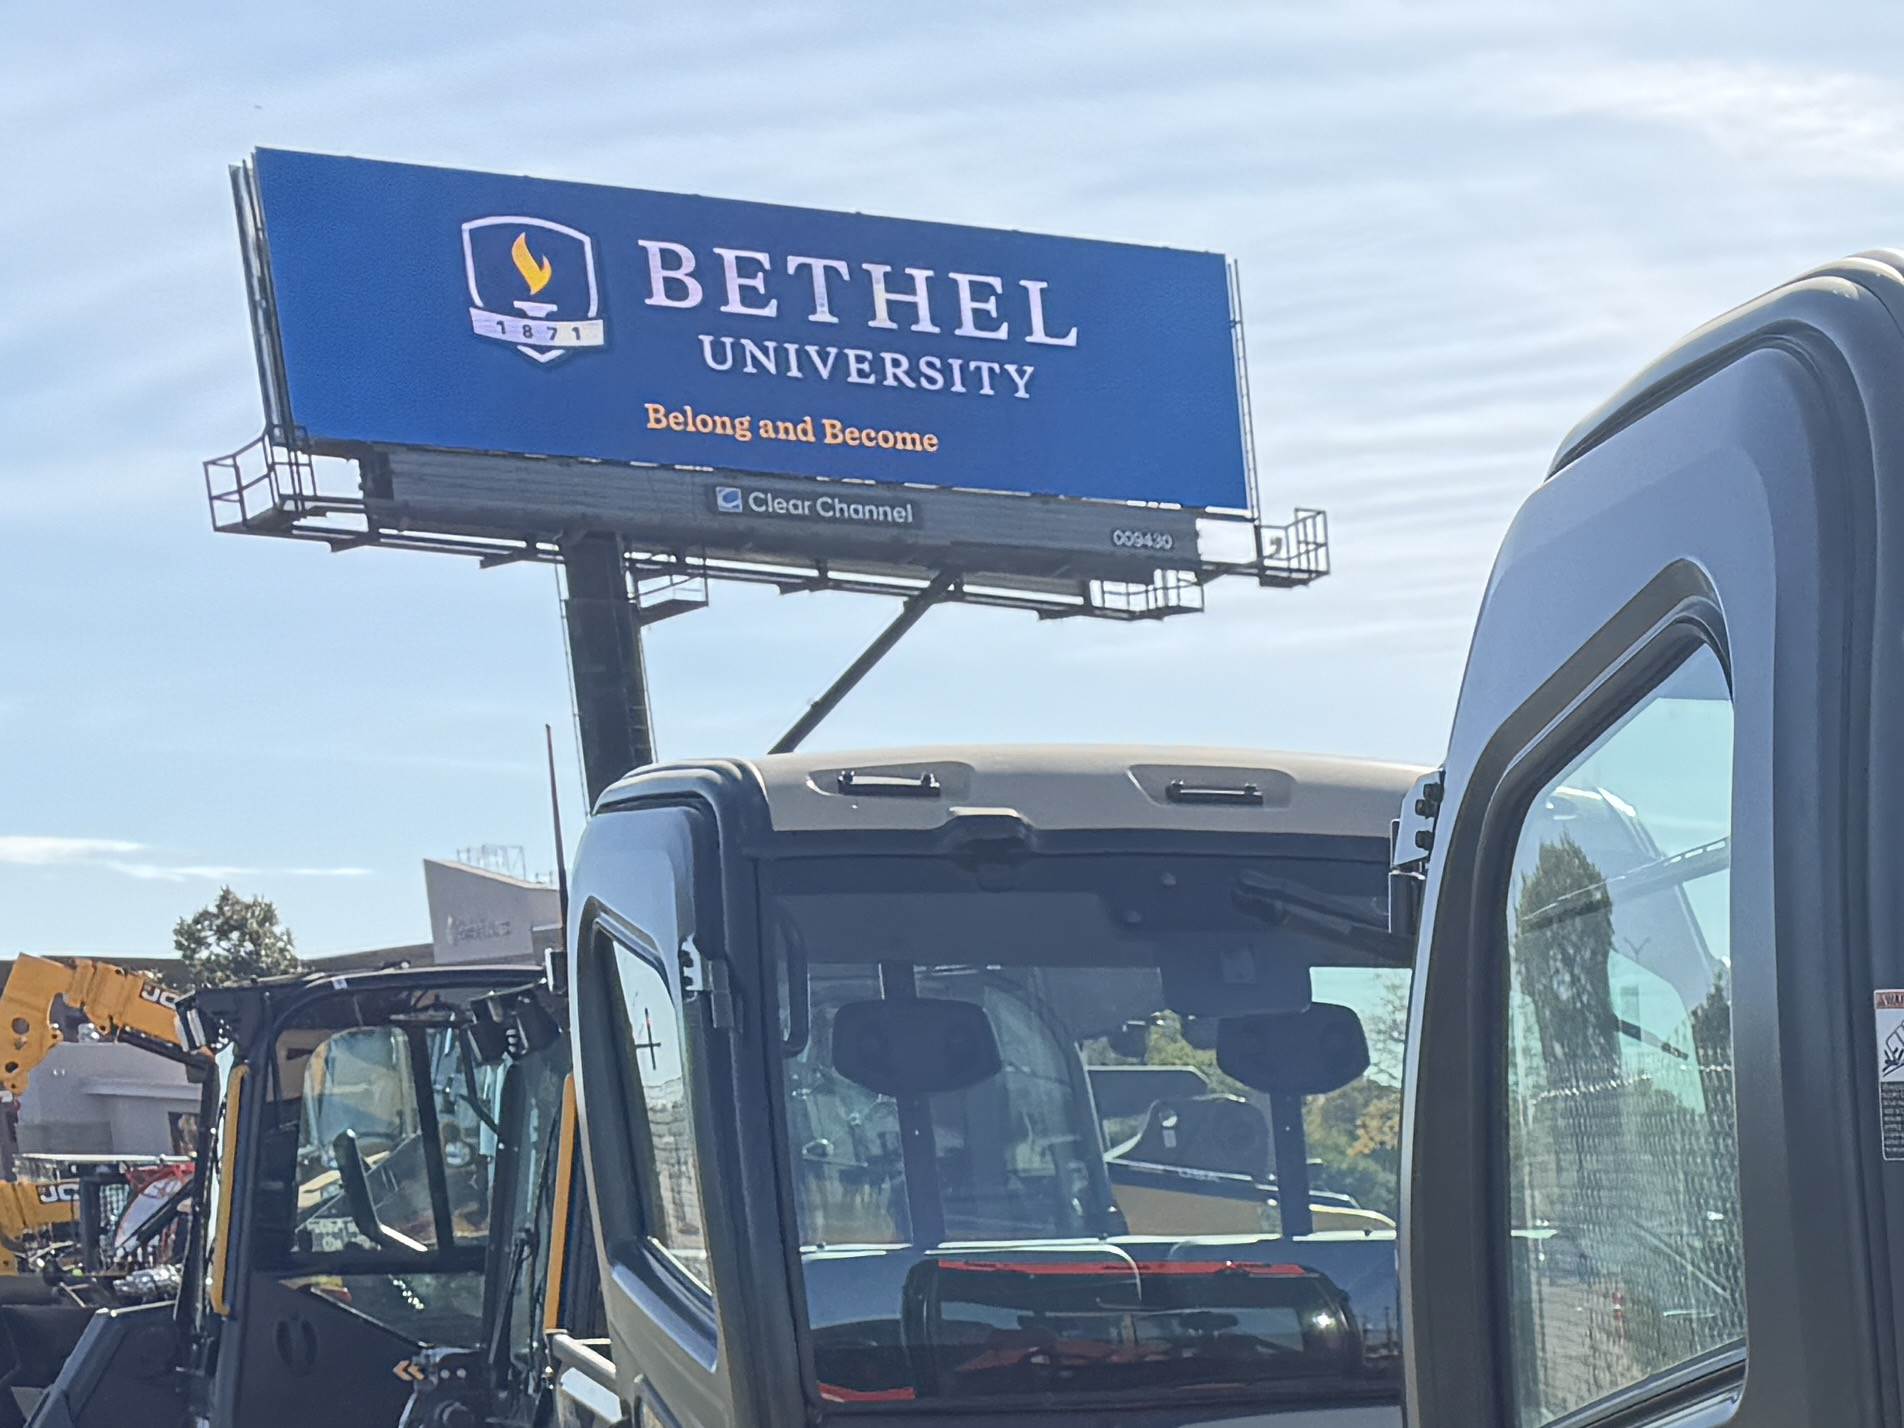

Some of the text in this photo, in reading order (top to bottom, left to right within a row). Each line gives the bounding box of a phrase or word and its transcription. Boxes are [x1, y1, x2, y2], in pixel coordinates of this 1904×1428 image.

[637, 239, 1079, 348] BETHEL
[495, 319, 582, 342] 1871
[699, 334, 1036, 399] UNIVERSITY
[645, 403, 940, 453] Belong and Become
[747, 491, 914, 524] Clear Channel
[1112, 528, 1173, 551] 009430
[141, 986, 181, 1010] JC
[38, 1183, 81, 1204] JC
